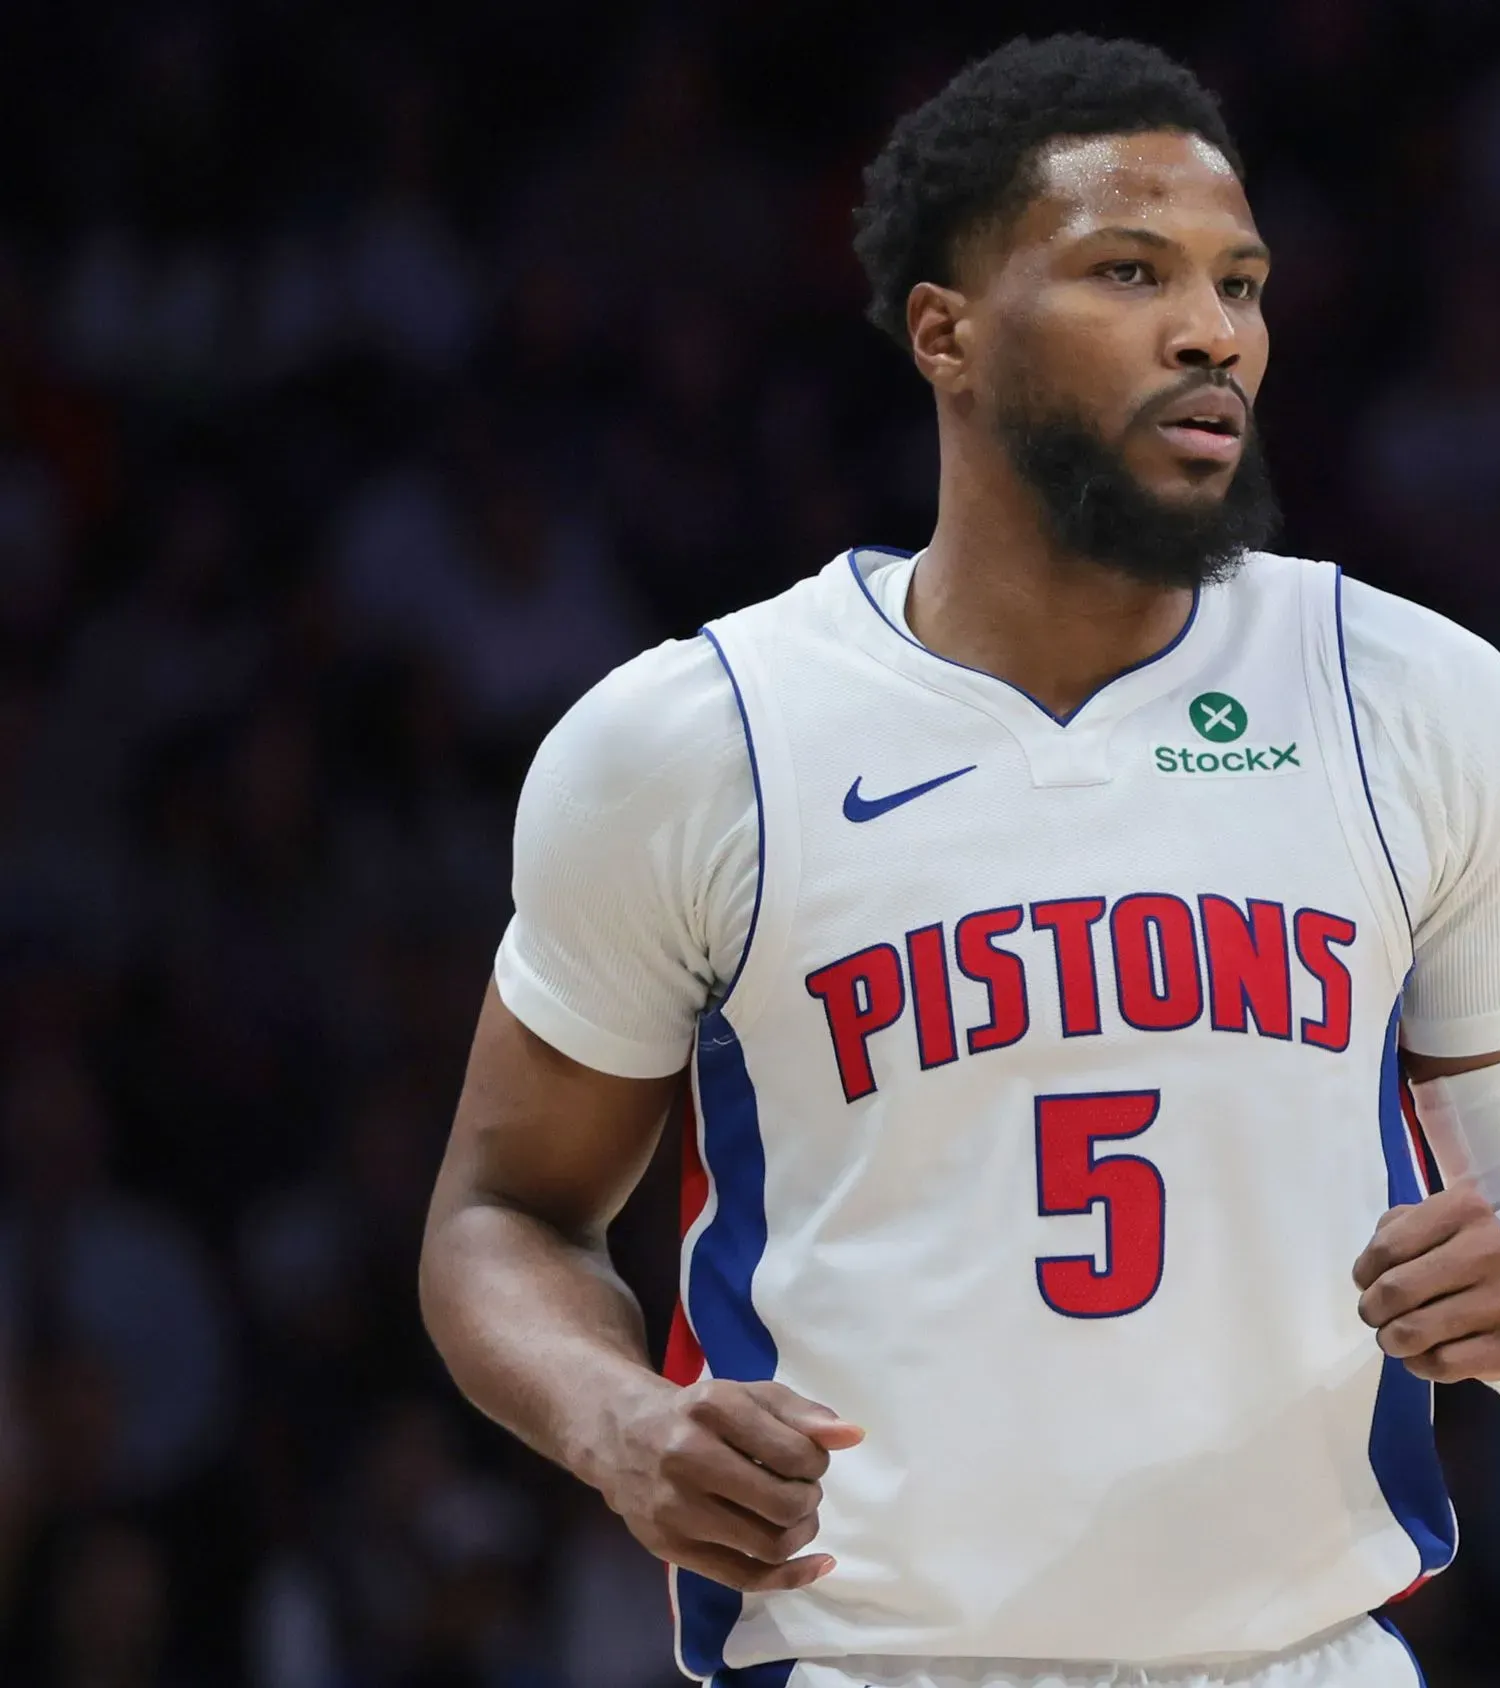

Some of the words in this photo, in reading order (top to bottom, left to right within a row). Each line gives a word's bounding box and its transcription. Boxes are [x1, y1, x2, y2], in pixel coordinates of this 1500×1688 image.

[1155, 742, 1301, 773] StockX
[805, 892, 1356, 1104] PISTONS
[1034, 1089, 1166, 1319] 5
